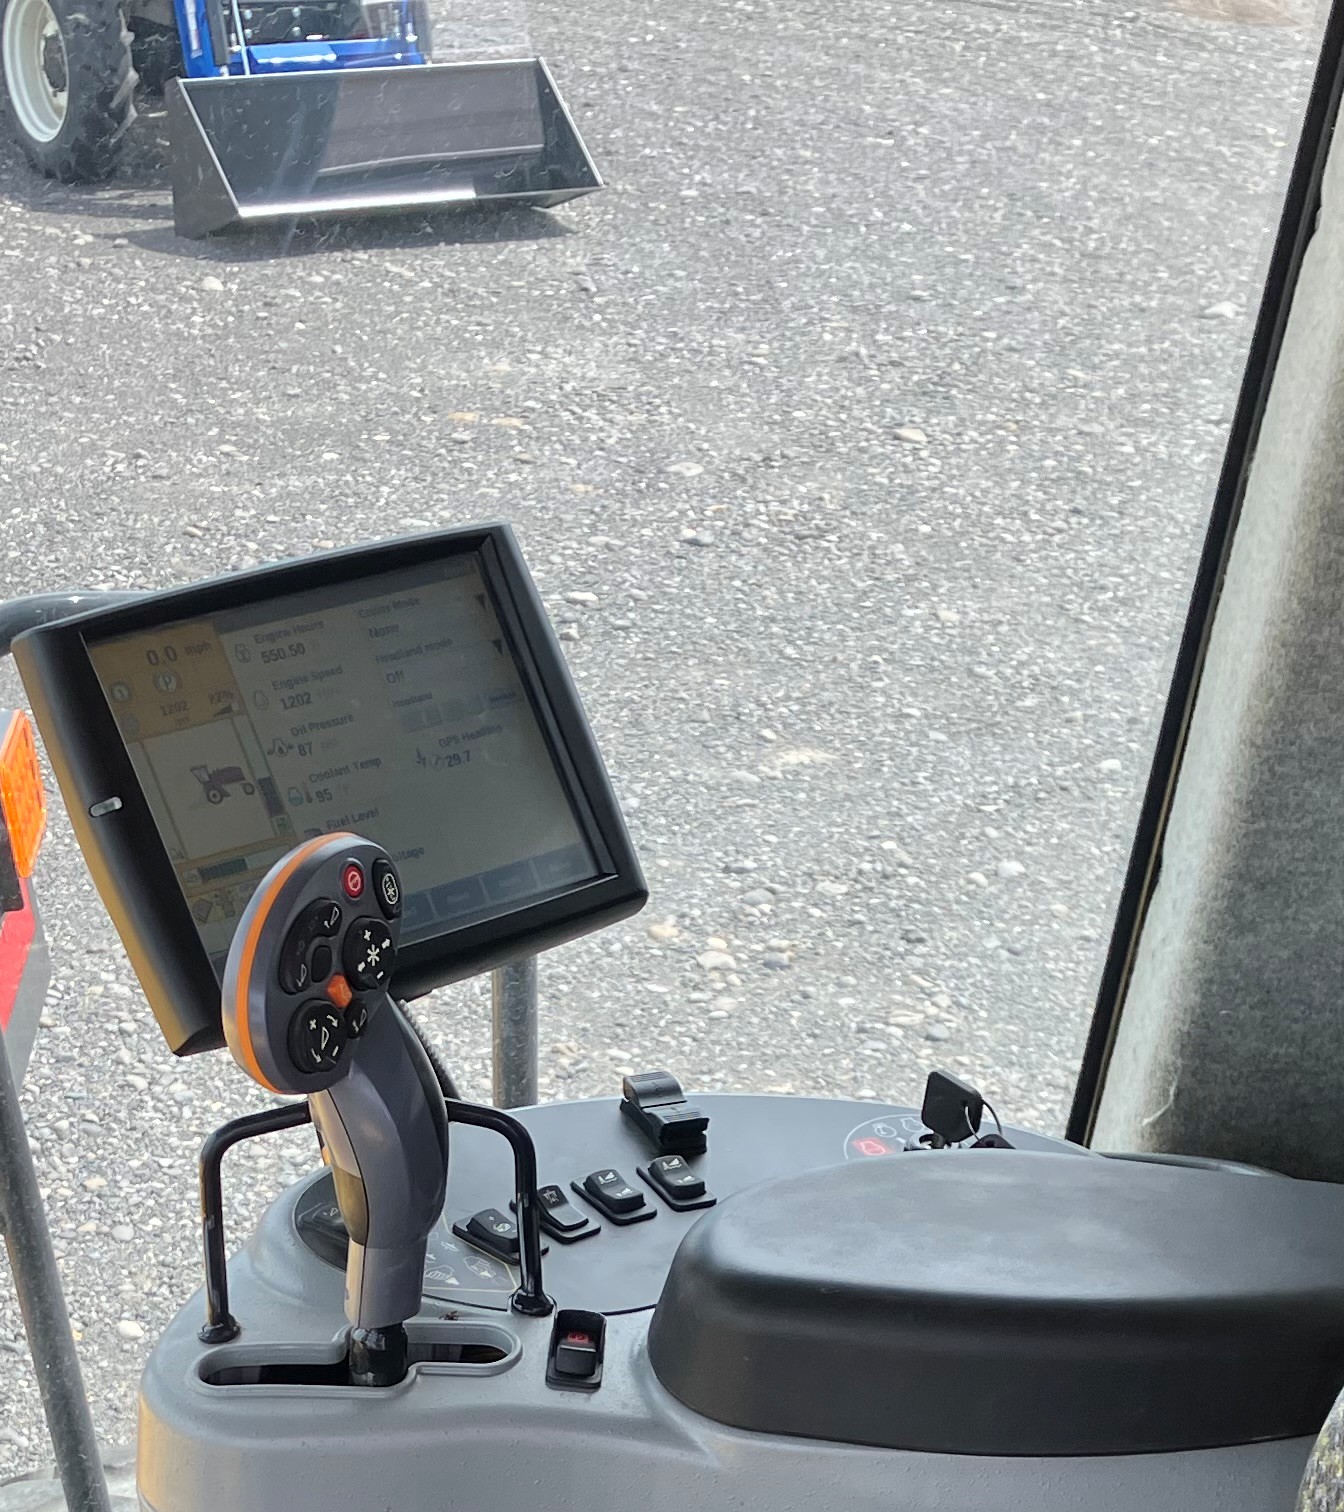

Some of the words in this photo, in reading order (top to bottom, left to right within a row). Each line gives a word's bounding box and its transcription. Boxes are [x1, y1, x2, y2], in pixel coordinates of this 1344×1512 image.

[253, 628, 291, 645] Engine
[146, 645, 179, 667] 0.0
[260, 641, 306, 665] 550.50
[271, 673, 311, 692] Engine
[311, 663, 345, 683] Speed
[160, 700, 191, 717] 1202
[280, 691, 313, 711] 1202
[289, 724, 308, 738] Oil
[308, 713, 355, 732] Pressure
[297, 741, 313, 757] 87
[445, 749, 471, 768] 29.7
[308, 763, 352, 783] Coolant
[352, 756, 383, 772] Temp
[314, 787, 333, 804] 95
[325, 814, 349, 831] Fuel
[350, 805, 380, 824] Level
[393, 846, 426, 863] oltage
